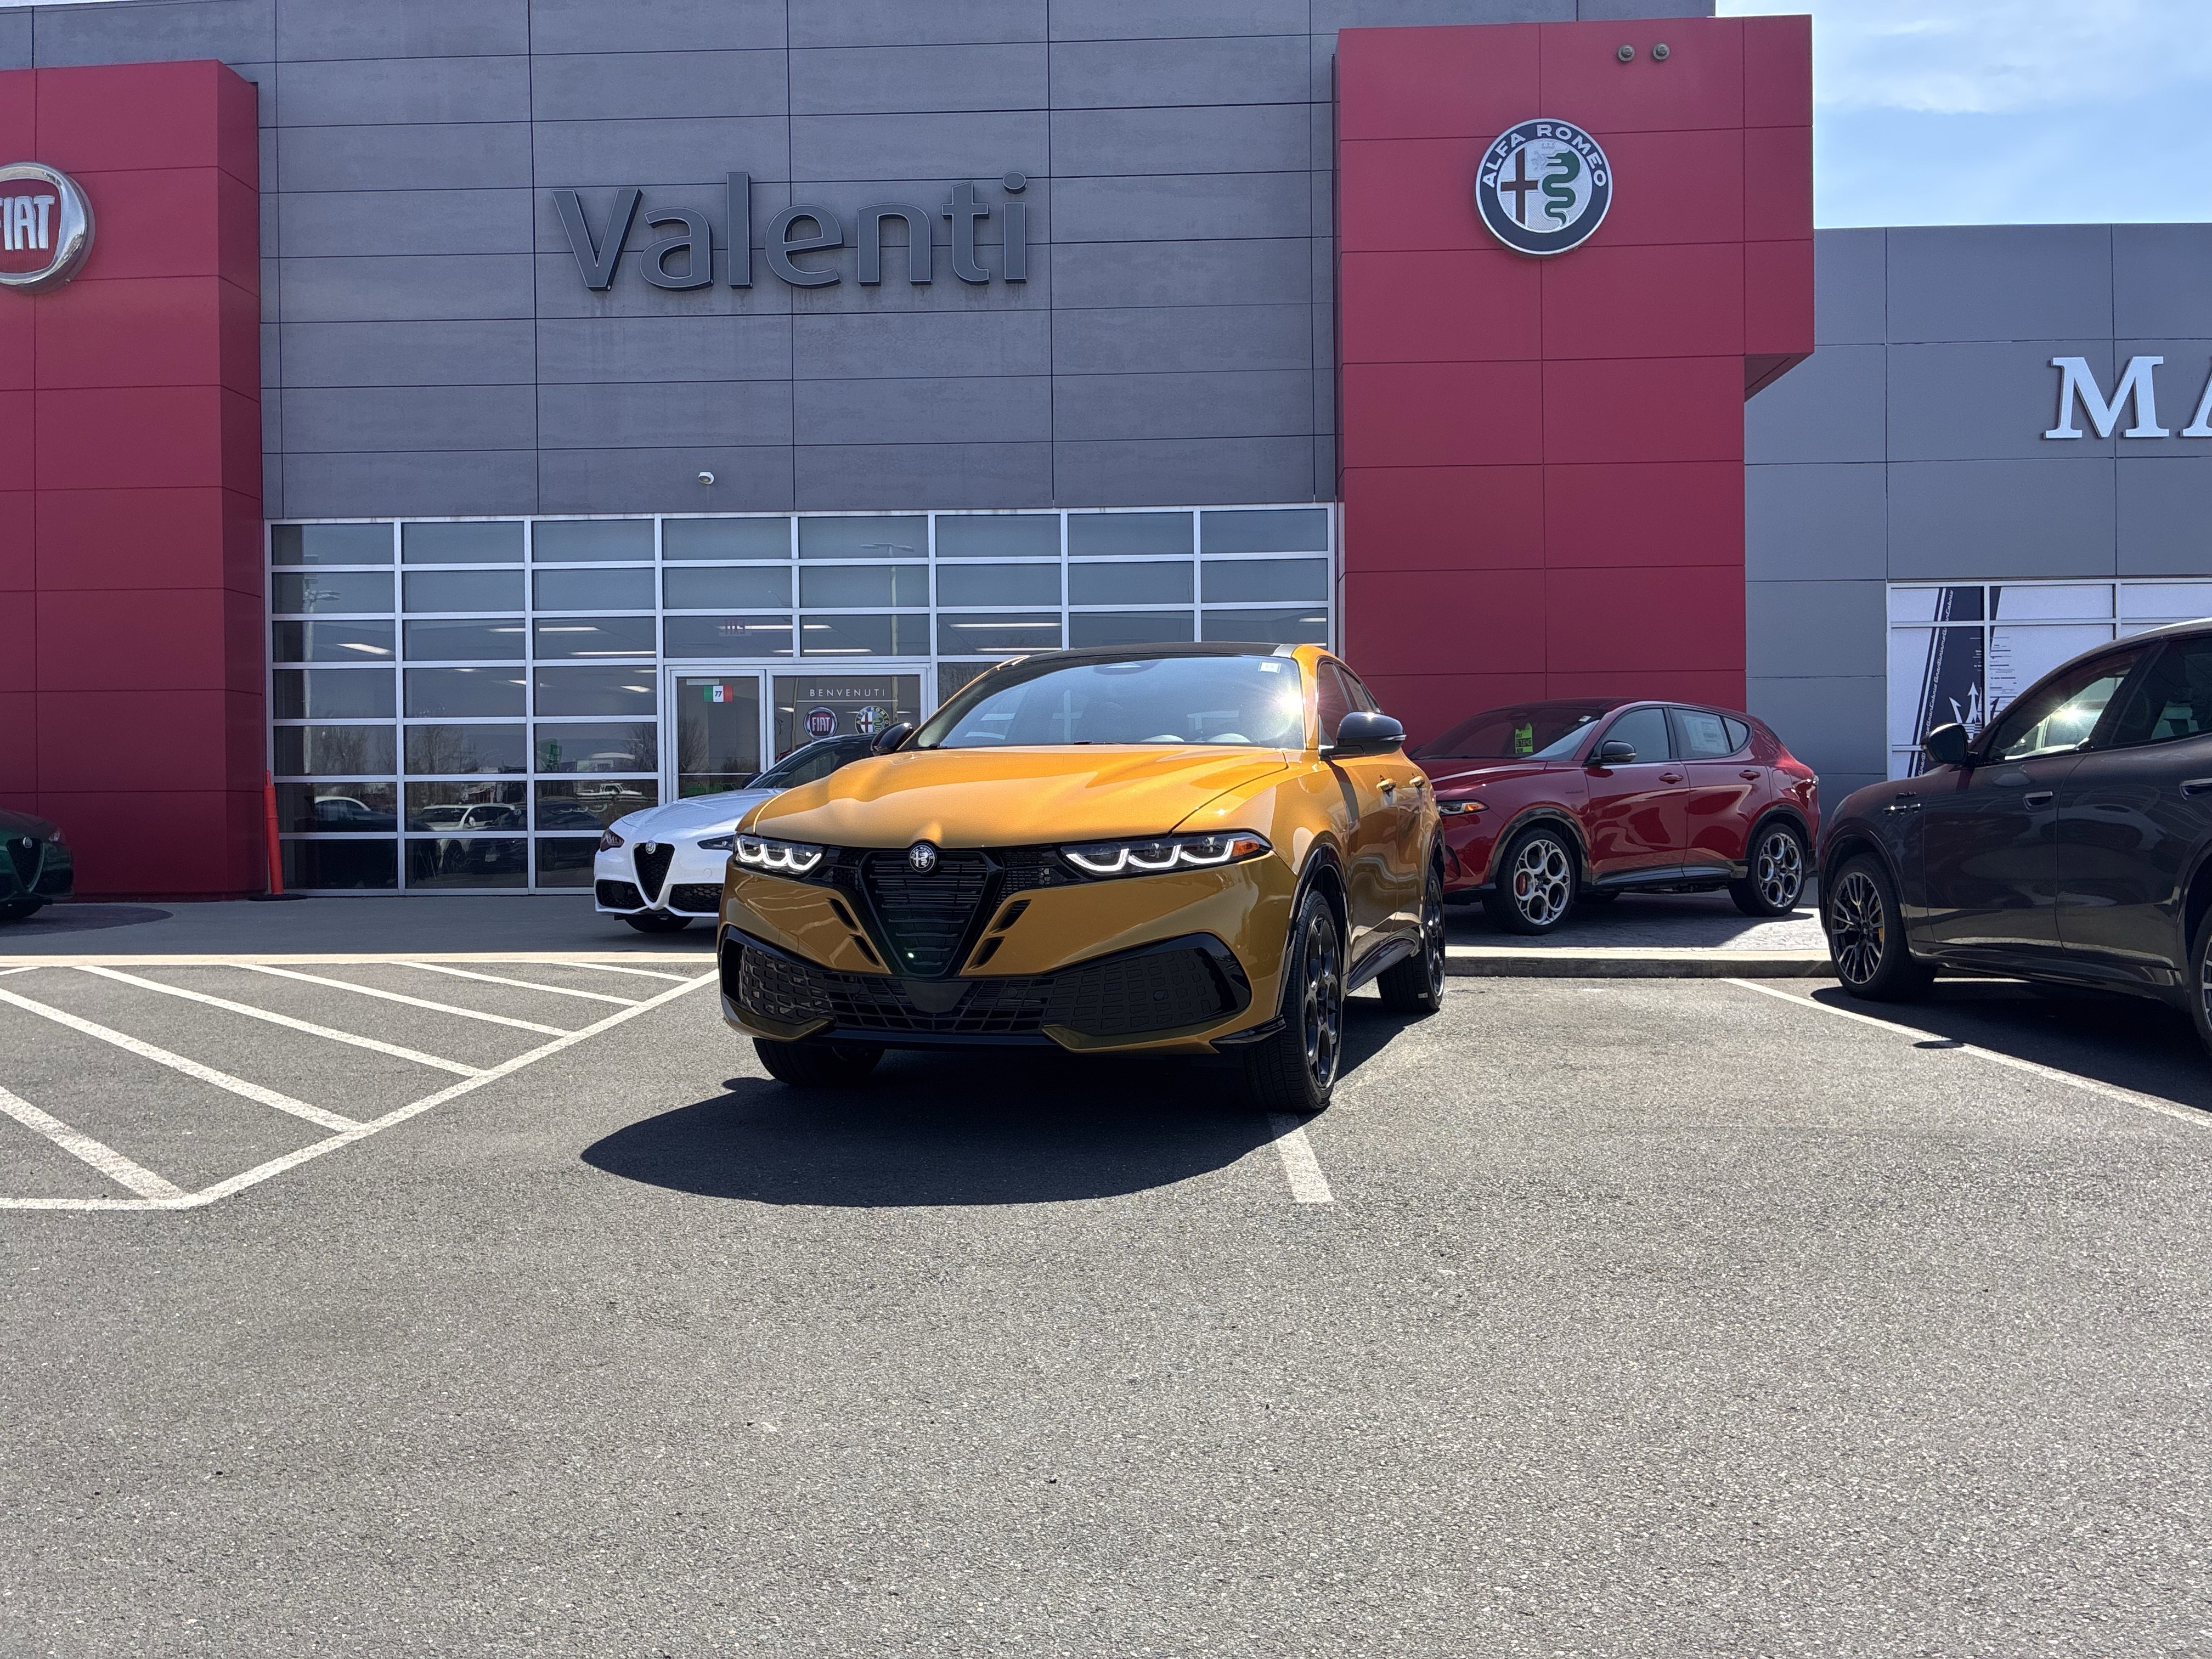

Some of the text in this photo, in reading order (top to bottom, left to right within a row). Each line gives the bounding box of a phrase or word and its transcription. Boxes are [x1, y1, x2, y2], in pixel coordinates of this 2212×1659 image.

[1482, 125, 1606, 188] ALFA ROMEO
[0, 195, 55, 250] IAT
[551, 172, 1027, 291] Valenti
[810, 689, 885, 697] BENVENUTI
[812, 716, 830, 731] FIAT
[856, 707, 889, 724] ALFA ROMEO
